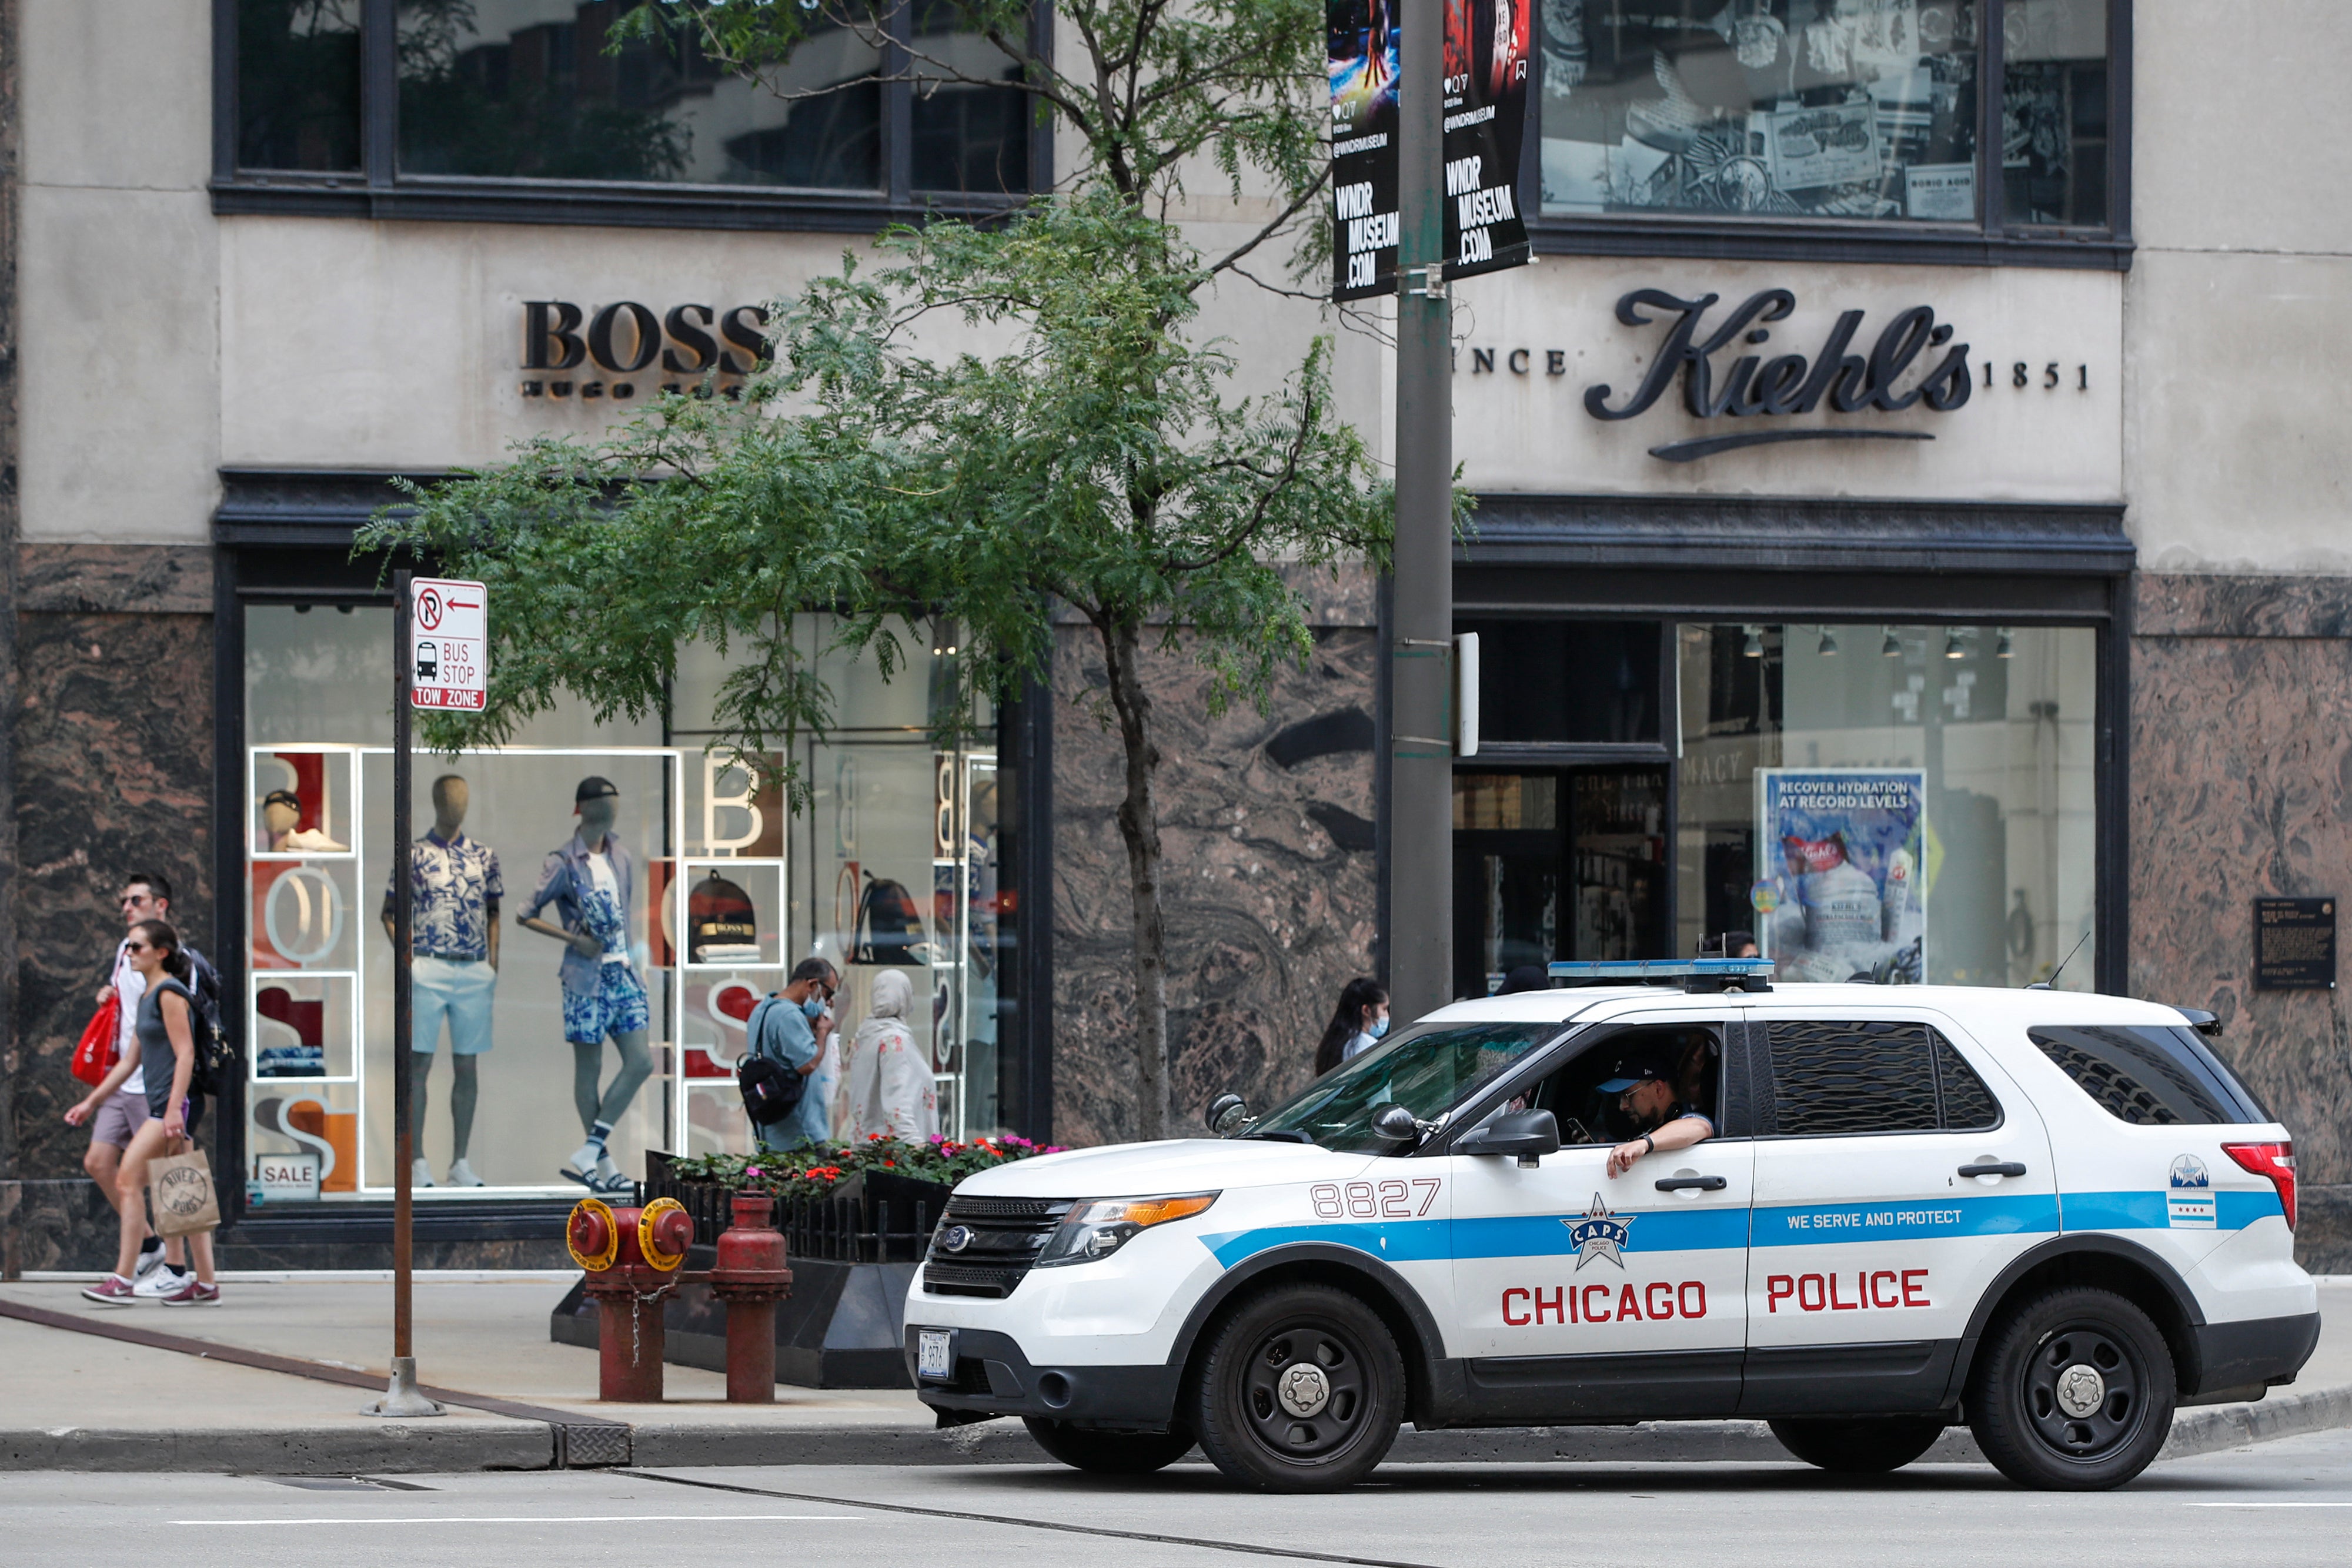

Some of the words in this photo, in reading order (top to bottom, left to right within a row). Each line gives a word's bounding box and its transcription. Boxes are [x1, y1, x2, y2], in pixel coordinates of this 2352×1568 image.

[1444, 105, 1495, 133] @WNDRMUSEUM
[1333, 132, 1388, 158] @WNDRMUSEUM
[1446, 155, 1482, 196] WNDR
[1335, 181, 1374, 220] WNDR
[1458, 185, 1516, 230] MUSEUM
[1348, 212, 1399, 253] MUSEUM
[1458, 226, 1493, 266] .COM
[1346, 252, 1376, 289] .COM
[521, 301, 775, 375] BOSS
[1452, 347, 1566, 375] INCE
[1584, 288, 1972, 421] Kiehl's
[1982, 362, 2089, 391] 1851
[444, 643, 468, 662] BUS
[443, 665, 475, 684] STOP
[416, 688, 441, 705] TOW
[447, 690, 479, 707] ZONE
[1779, 781, 1835, 794] RECOVER
[1838, 781, 1907, 793] HYDRATION
[1779, 795, 1797, 808] AT
[1800, 795, 1856, 808] RECORD
[1860, 795, 1908, 809] LEVELS
[166, 1168, 196, 1188] RIVER
[265, 1166, 313, 1182] SALE
[1311, 1178, 1441, 1218] 8827
[1574, 1223, 1624, 1242] CAPS
[1788, 1215, 1810, 1229] WE
[1813, 1213, 1861, 1228] SERVE
[1865, 1211, 1893, 1226] AND
[1897, 1209, 1962, 1225] PROTECT
[1502, 1281, 1707, 1326] CHICAGO
[1768, 1269, 1931, 1313] POLICE
